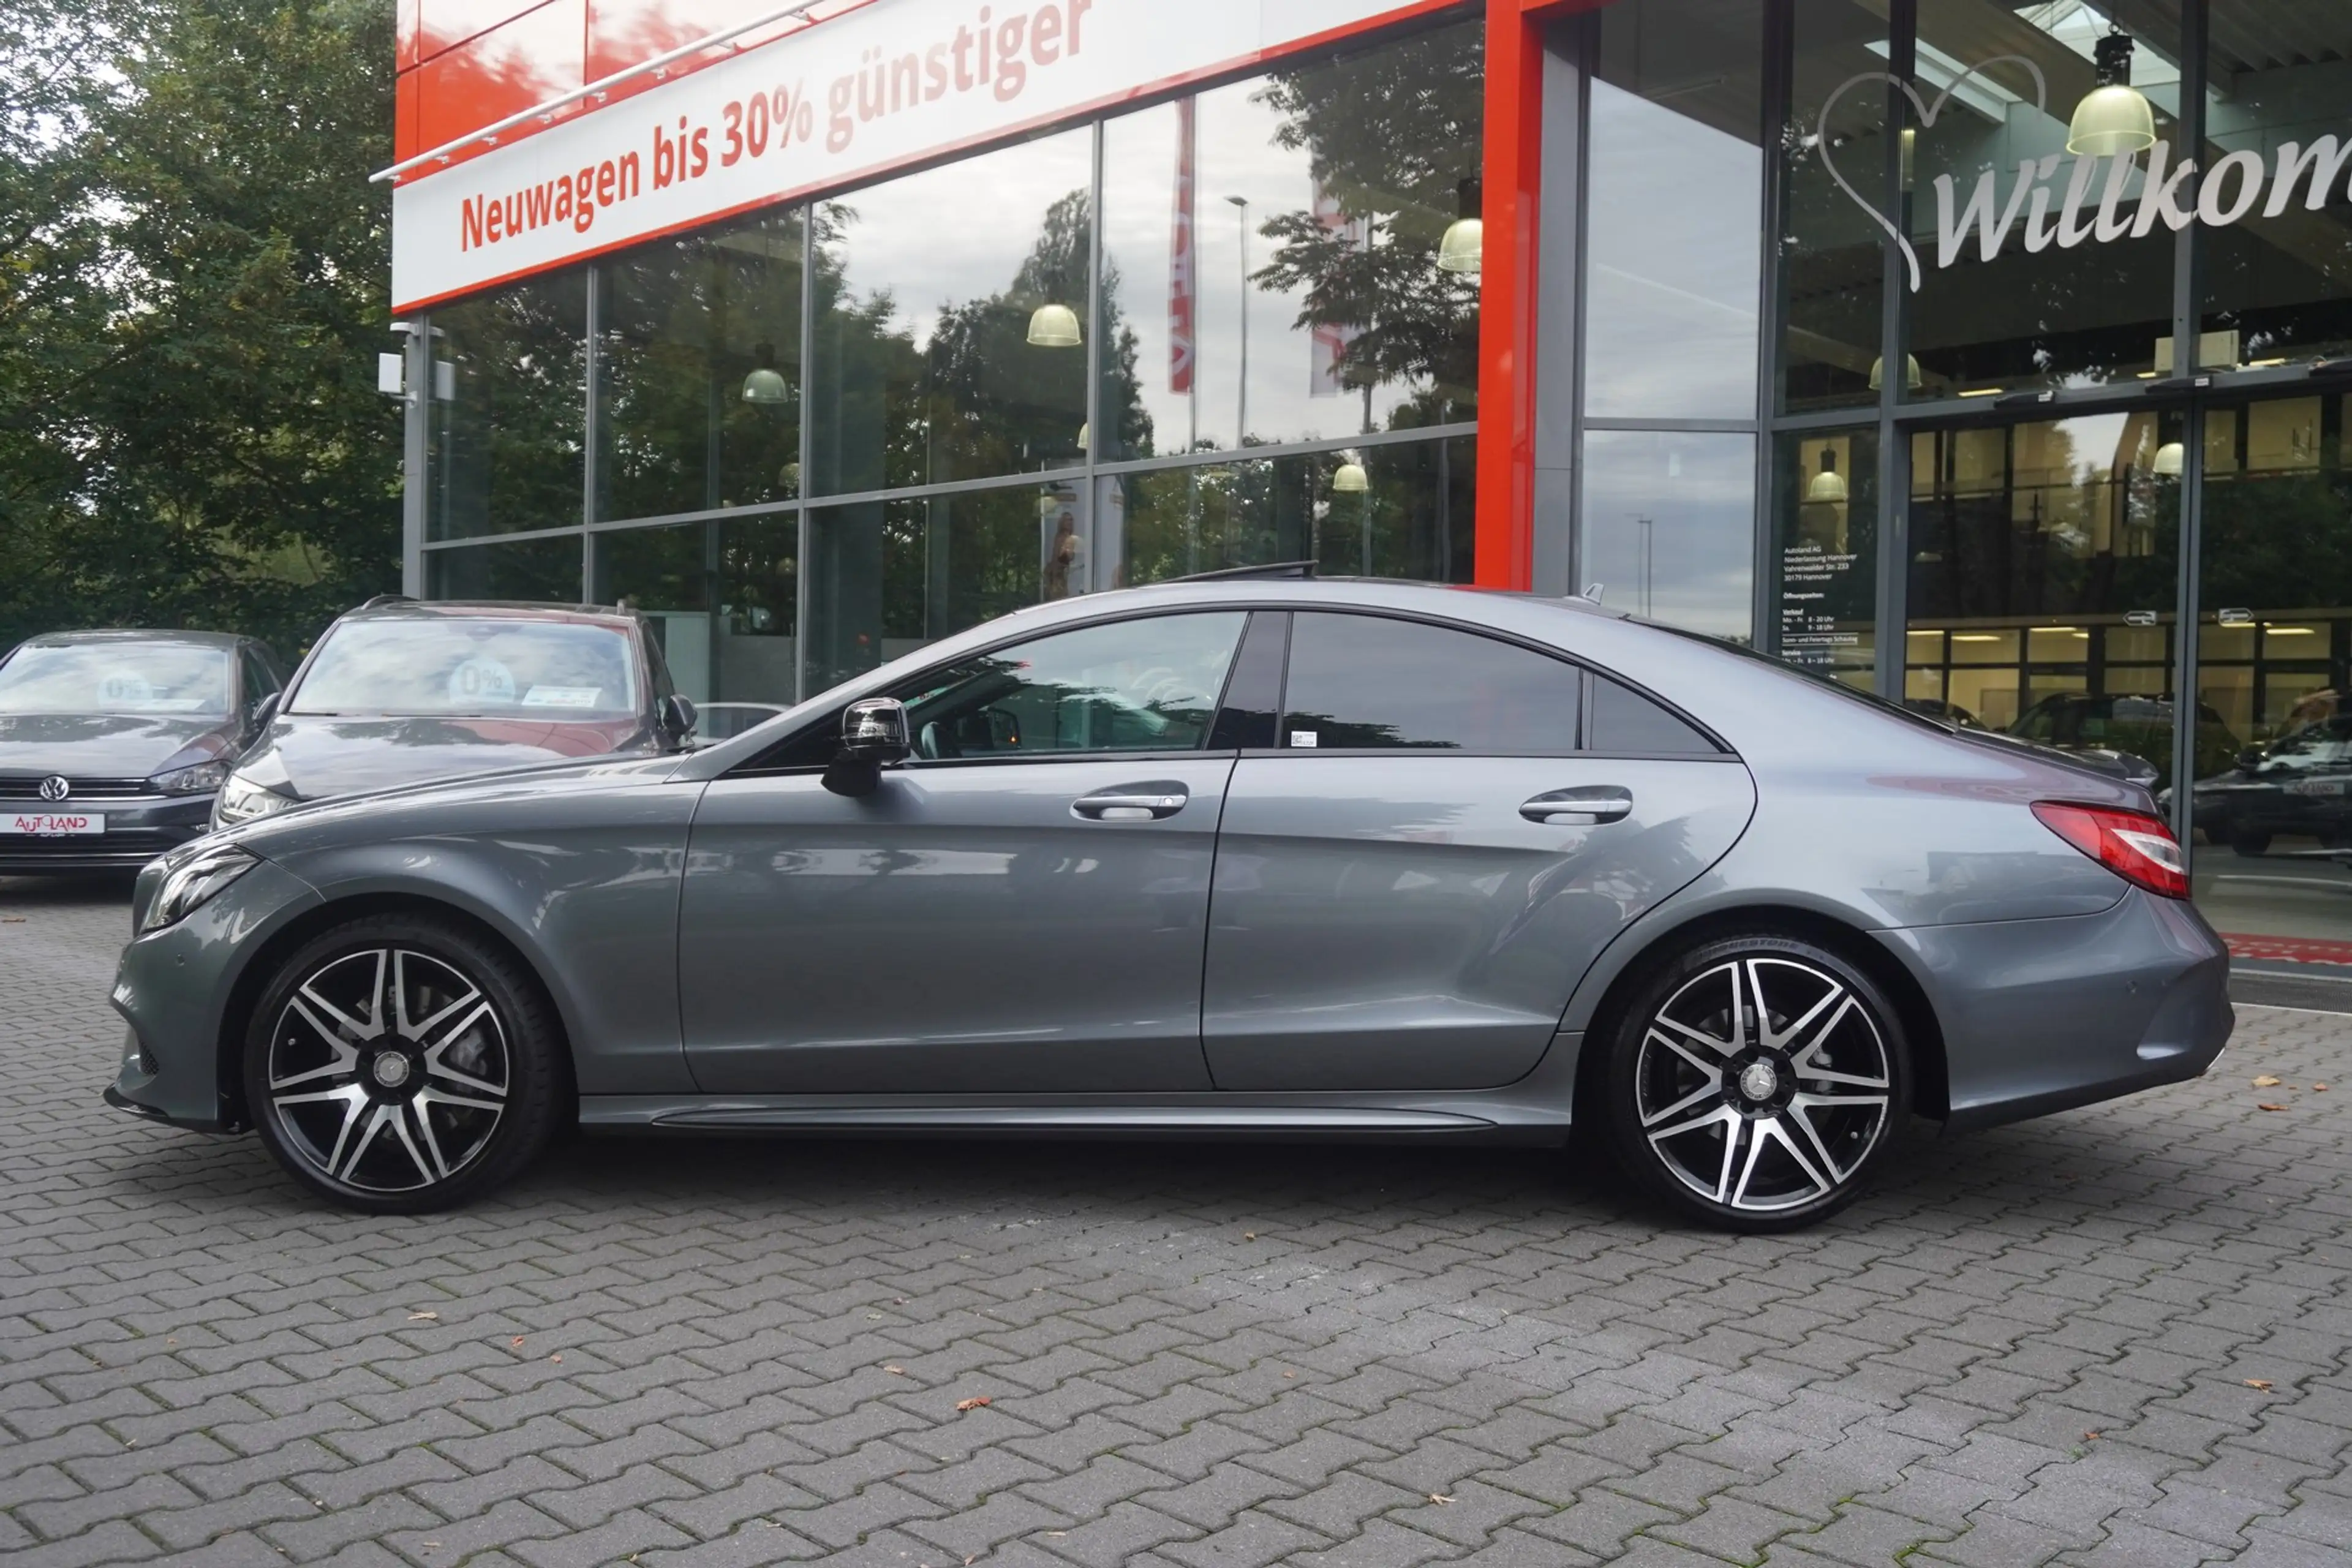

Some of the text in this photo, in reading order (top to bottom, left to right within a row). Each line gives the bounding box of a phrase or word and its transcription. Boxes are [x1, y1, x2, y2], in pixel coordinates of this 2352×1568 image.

[461, 0, 1093, 251] Neuwagen bis 30% günstiger
